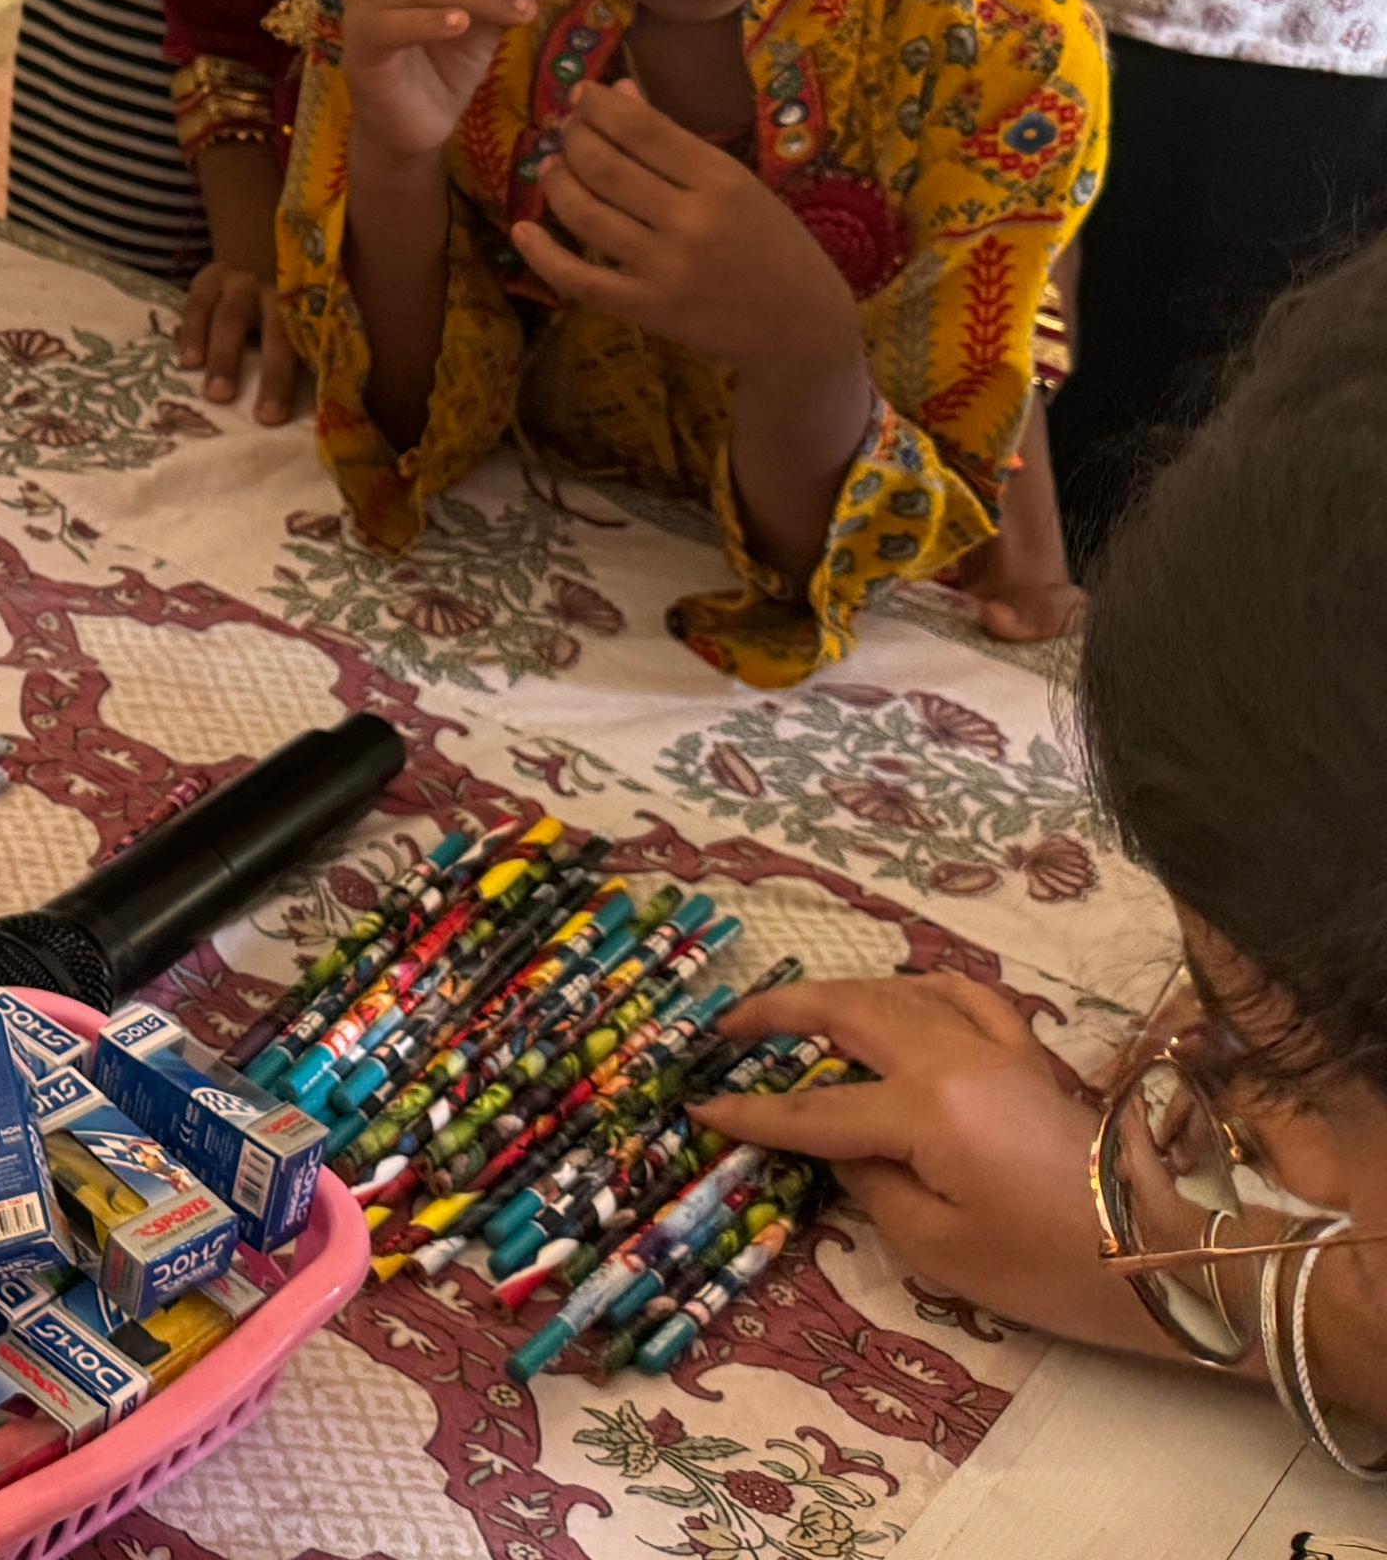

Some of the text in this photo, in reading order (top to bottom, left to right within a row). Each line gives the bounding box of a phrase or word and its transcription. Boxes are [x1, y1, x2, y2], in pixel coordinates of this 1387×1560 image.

[117, 1015, 162, 1044] DOMS
[35, 1077, 77, 1114] MS
[152, 1233, 229, 1287] DOMS
[34, 1324, 124, 1390] DOMS
